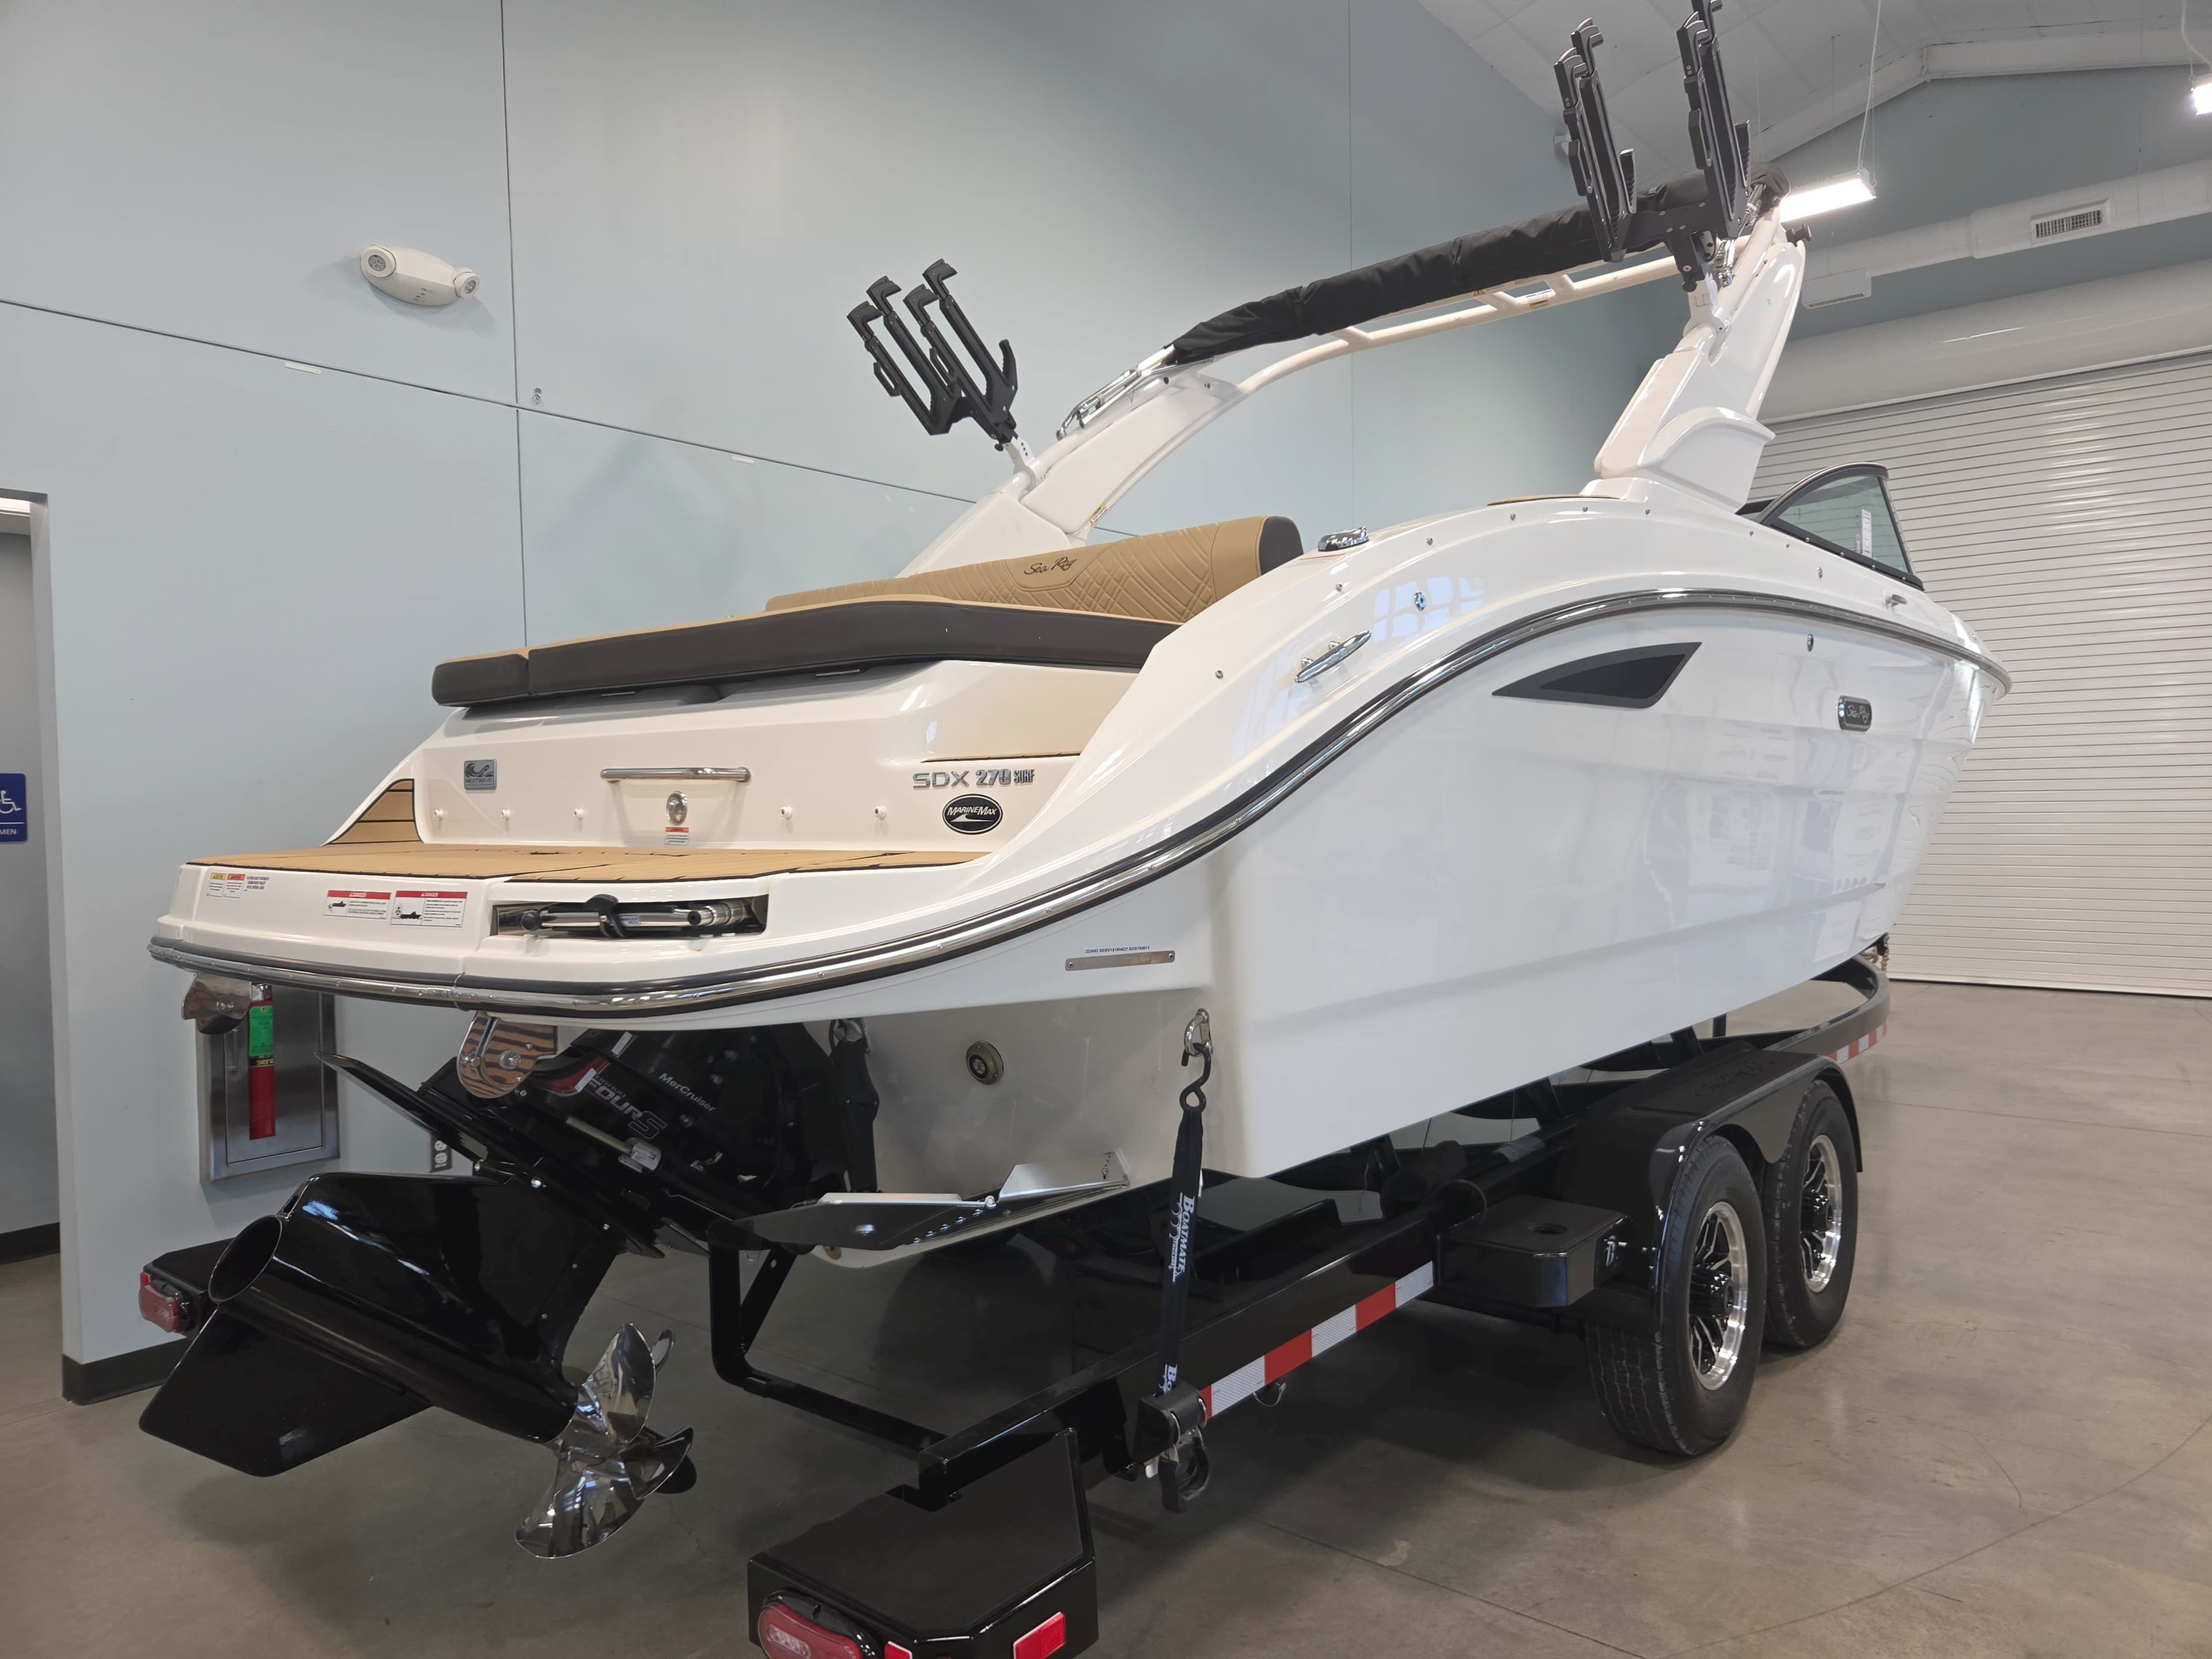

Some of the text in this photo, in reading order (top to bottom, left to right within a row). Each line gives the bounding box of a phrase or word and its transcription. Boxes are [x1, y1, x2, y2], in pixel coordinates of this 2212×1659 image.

[1024, 556, 1077, 575] Sea Ray
[912, 768, 1035, 789] SDX 270 SURF
[658, 1073, 717, 1112] MerCruiser
